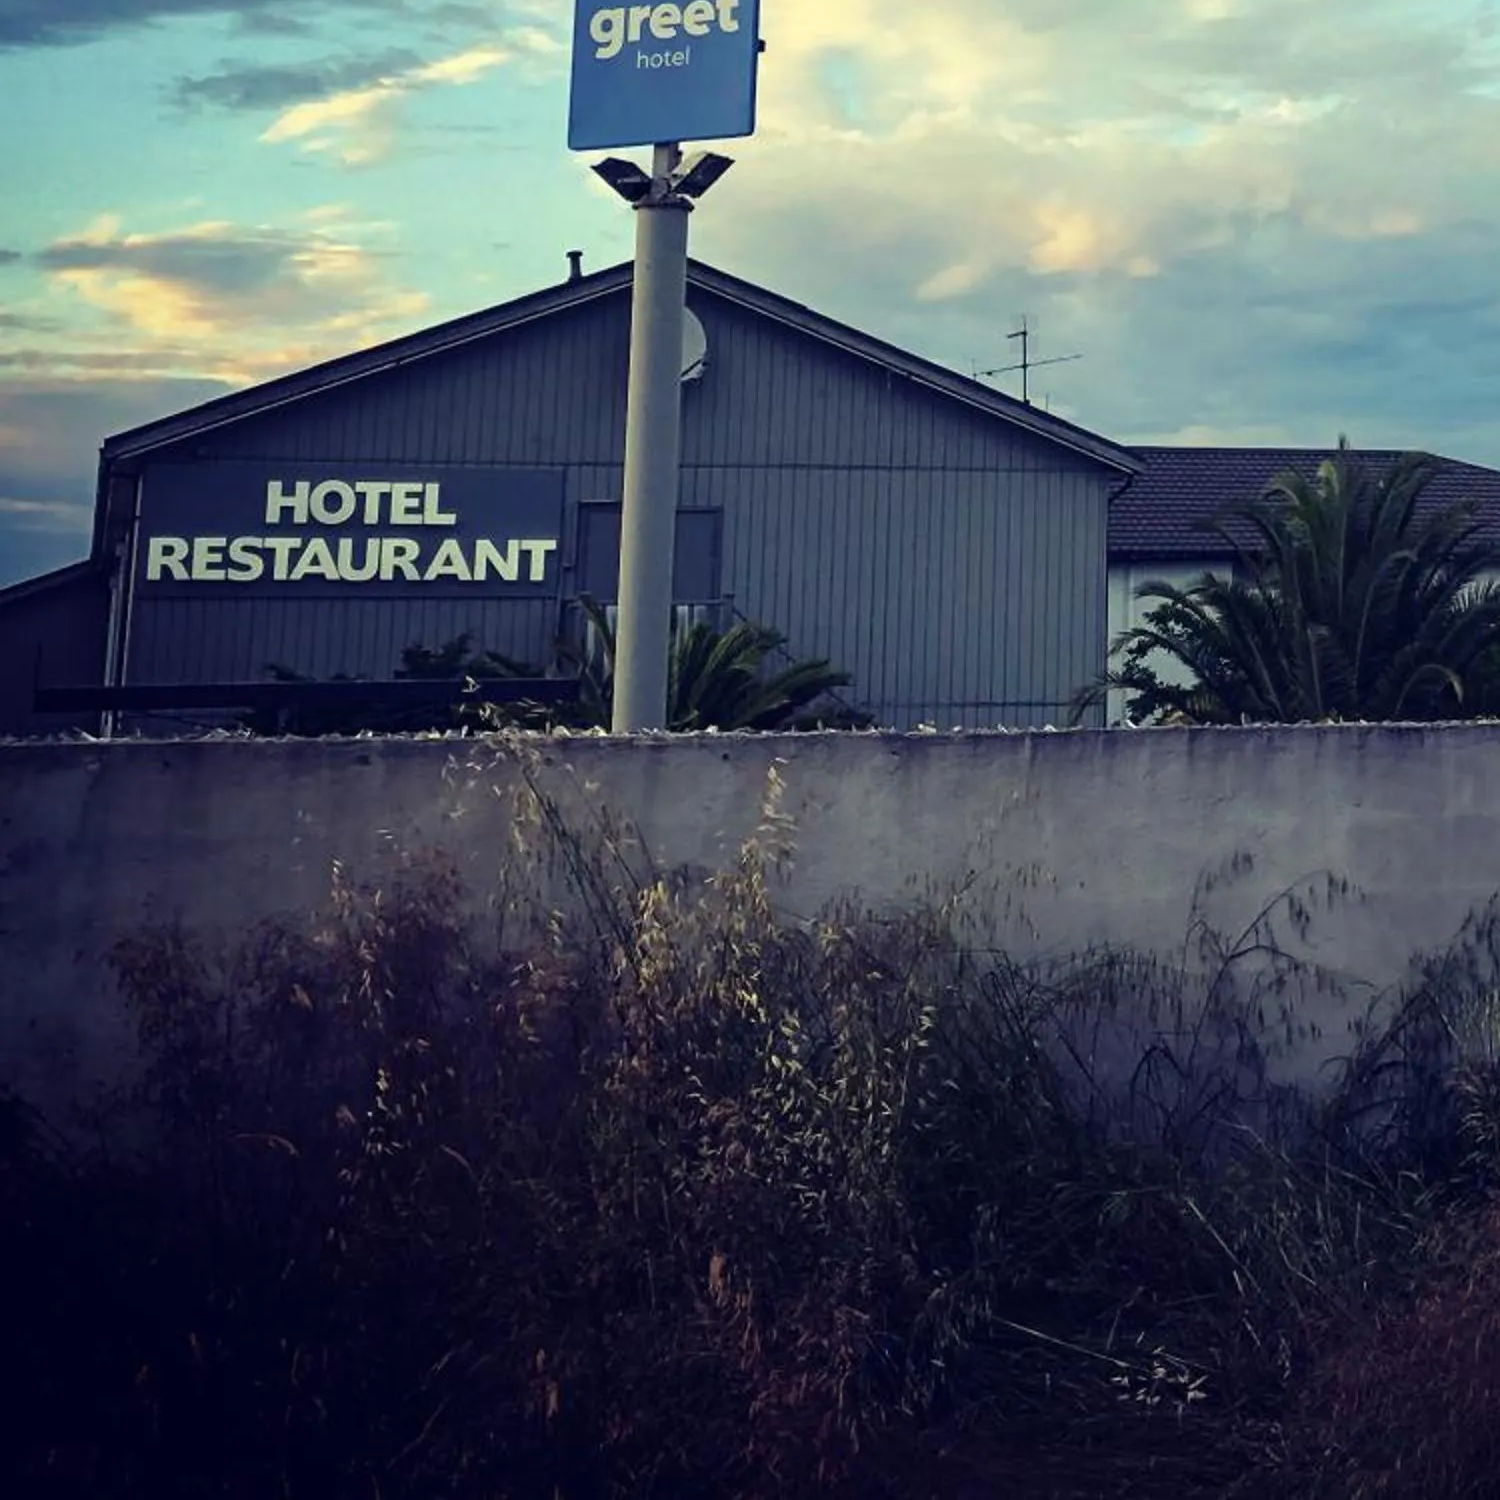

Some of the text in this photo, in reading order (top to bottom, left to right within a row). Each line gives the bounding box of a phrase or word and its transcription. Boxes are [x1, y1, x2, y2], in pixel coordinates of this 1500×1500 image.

[636, 45, 690, 68] hotel
[265, 479, 457, 525] HOTEL
[147, 537, 557, 581] RESTAURANT
